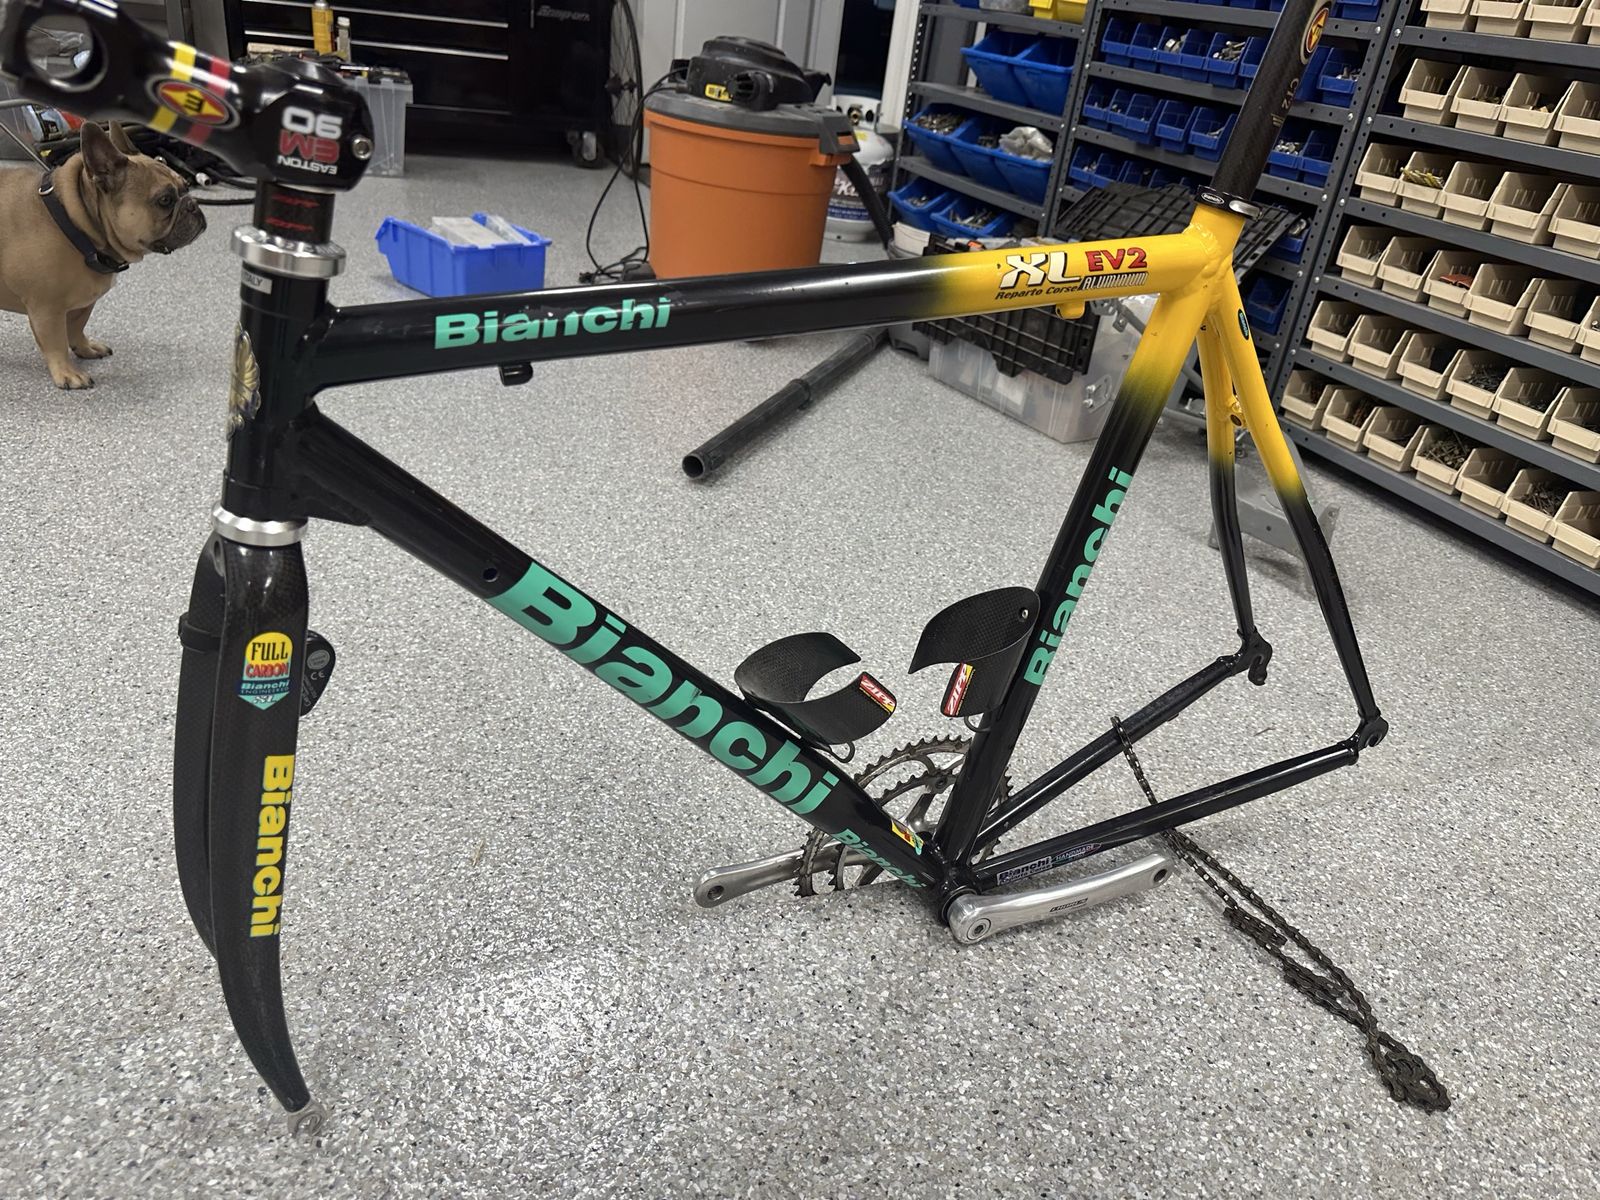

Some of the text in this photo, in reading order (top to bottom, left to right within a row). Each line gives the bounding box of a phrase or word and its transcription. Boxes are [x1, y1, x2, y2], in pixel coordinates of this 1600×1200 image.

[282, 106, 343, 140] 90
[279, 129, 340, 164] EM
[277, 155, 338, 175] EASTON
[1000, 246, 1148, 290] XL EV2
[1082, 271, 1149, 290] ALUMINIUM
[995, 284, 1080, 300] Reparto Corse
[434, 295, 671, 350] Bianchi
[1023, 468, 1132, 686] Bianchi
[251, 642, 288, 661] FULL
[241, 680, 289, 690] Bianchi
[245, 662, 289, 678] CARBON
[490, 561, 840, 814] Bianchi
[859, 679, 896, 706] ZIPP
[947, 663, 967, 715] ZIPP
[250, 754, 295, 938] Bianchi
[831, 828, 928, 888] Bianchi
[1055, 844, 1096, 861] HANDMADE
[1000, 857, 1050, 880] Bianchi
